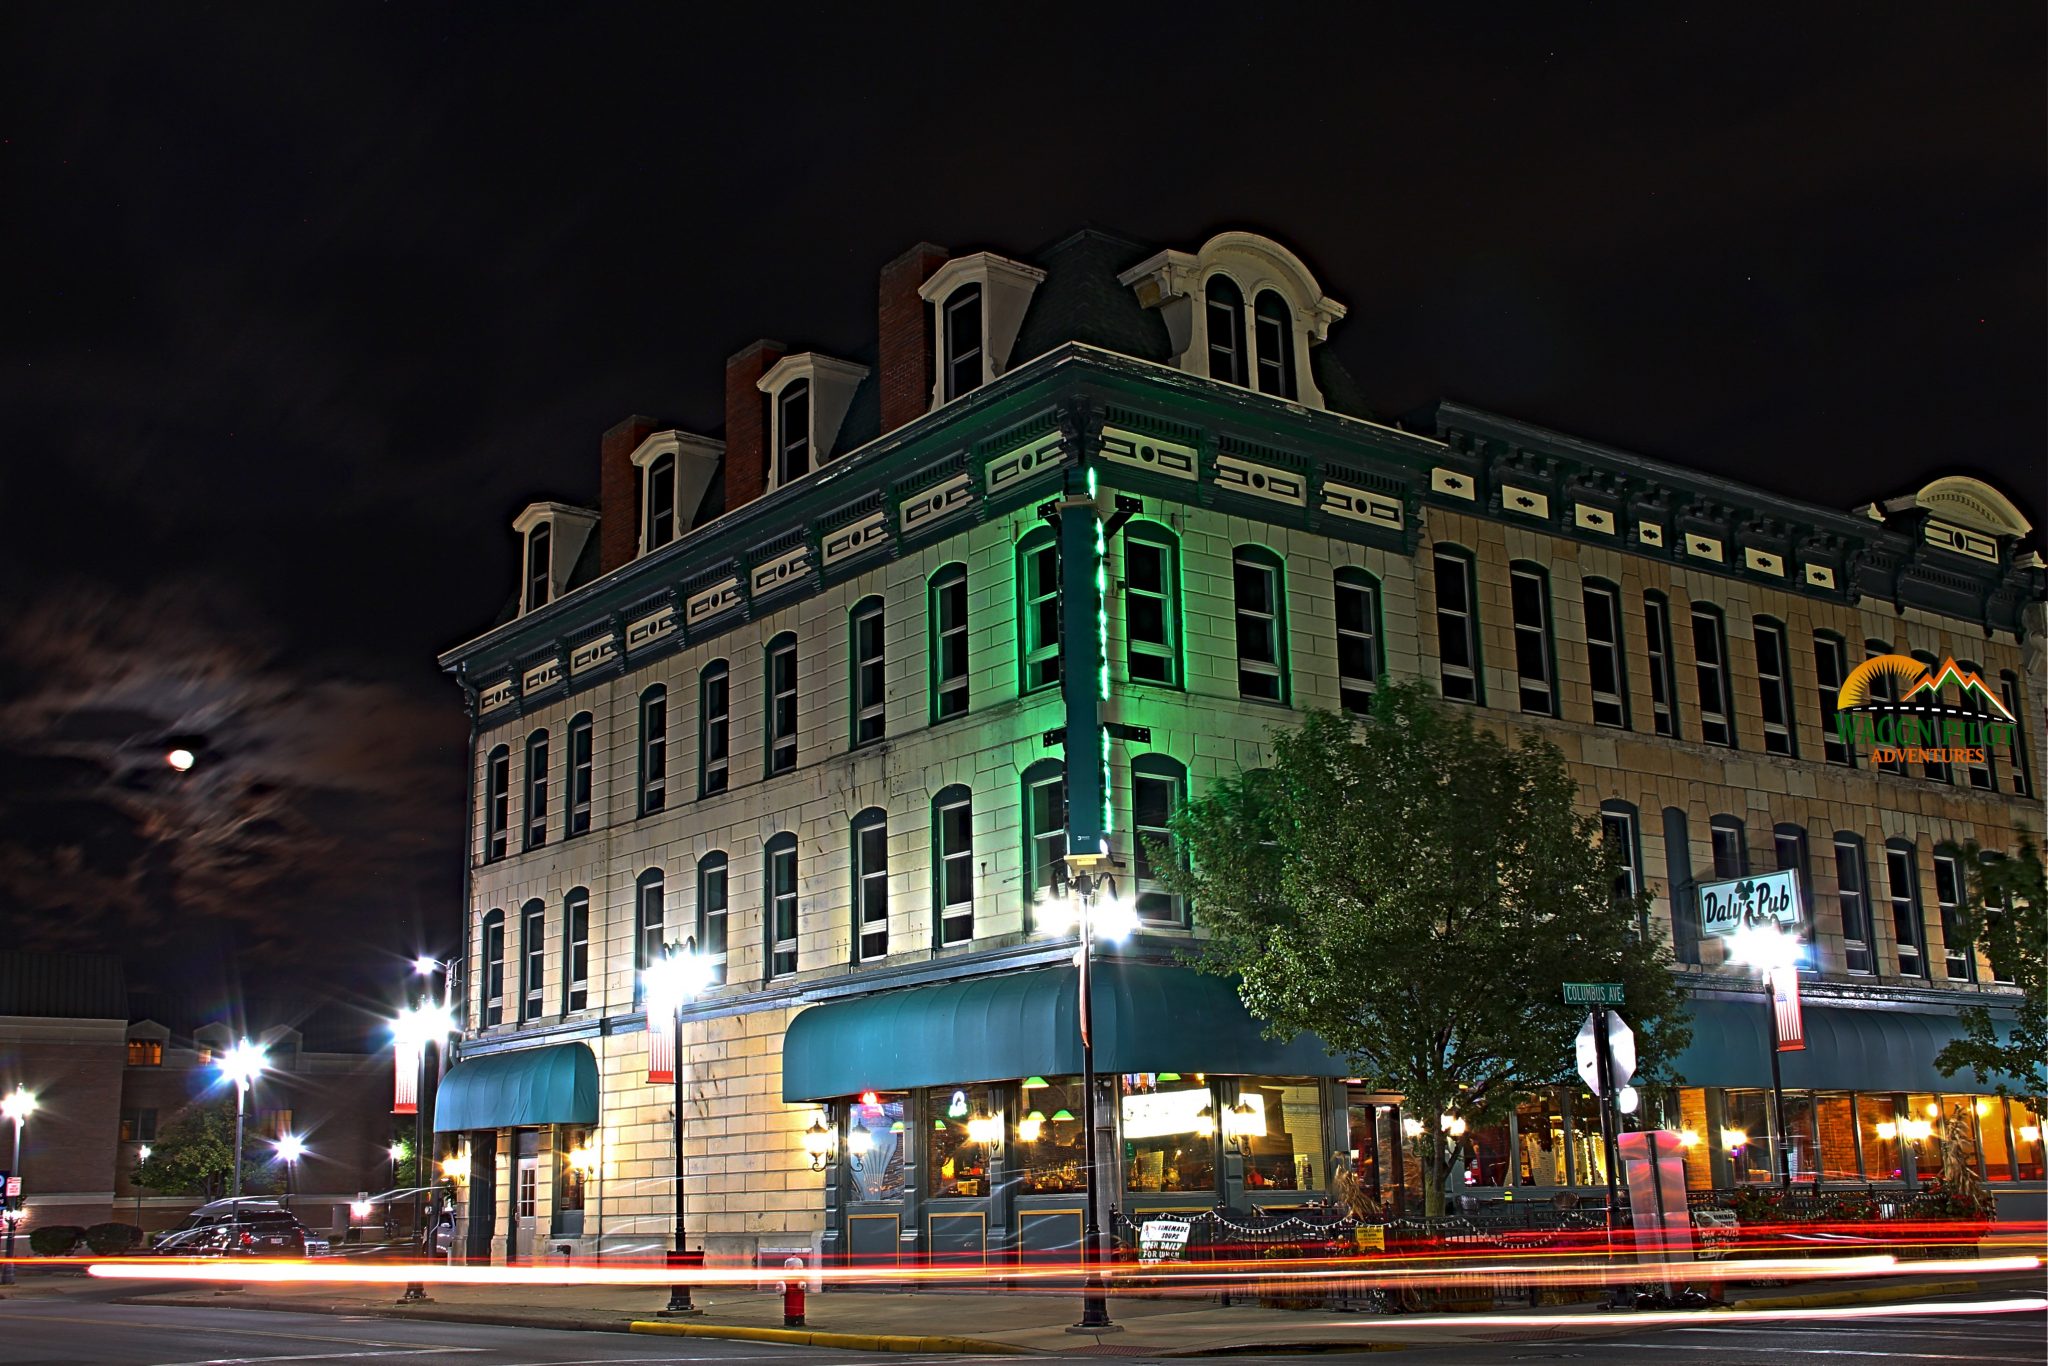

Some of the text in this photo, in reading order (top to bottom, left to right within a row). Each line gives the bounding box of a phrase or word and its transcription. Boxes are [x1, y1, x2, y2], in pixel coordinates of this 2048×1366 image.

[1704, 882, 1790, 928] Daly's Pub
[1567, 986, 1622, 1001] COLUMBUS AVE
[1142, 1241, 1182, 1251] OPEN DAILY
[1143, 1250, 1157, 1258] FOR
